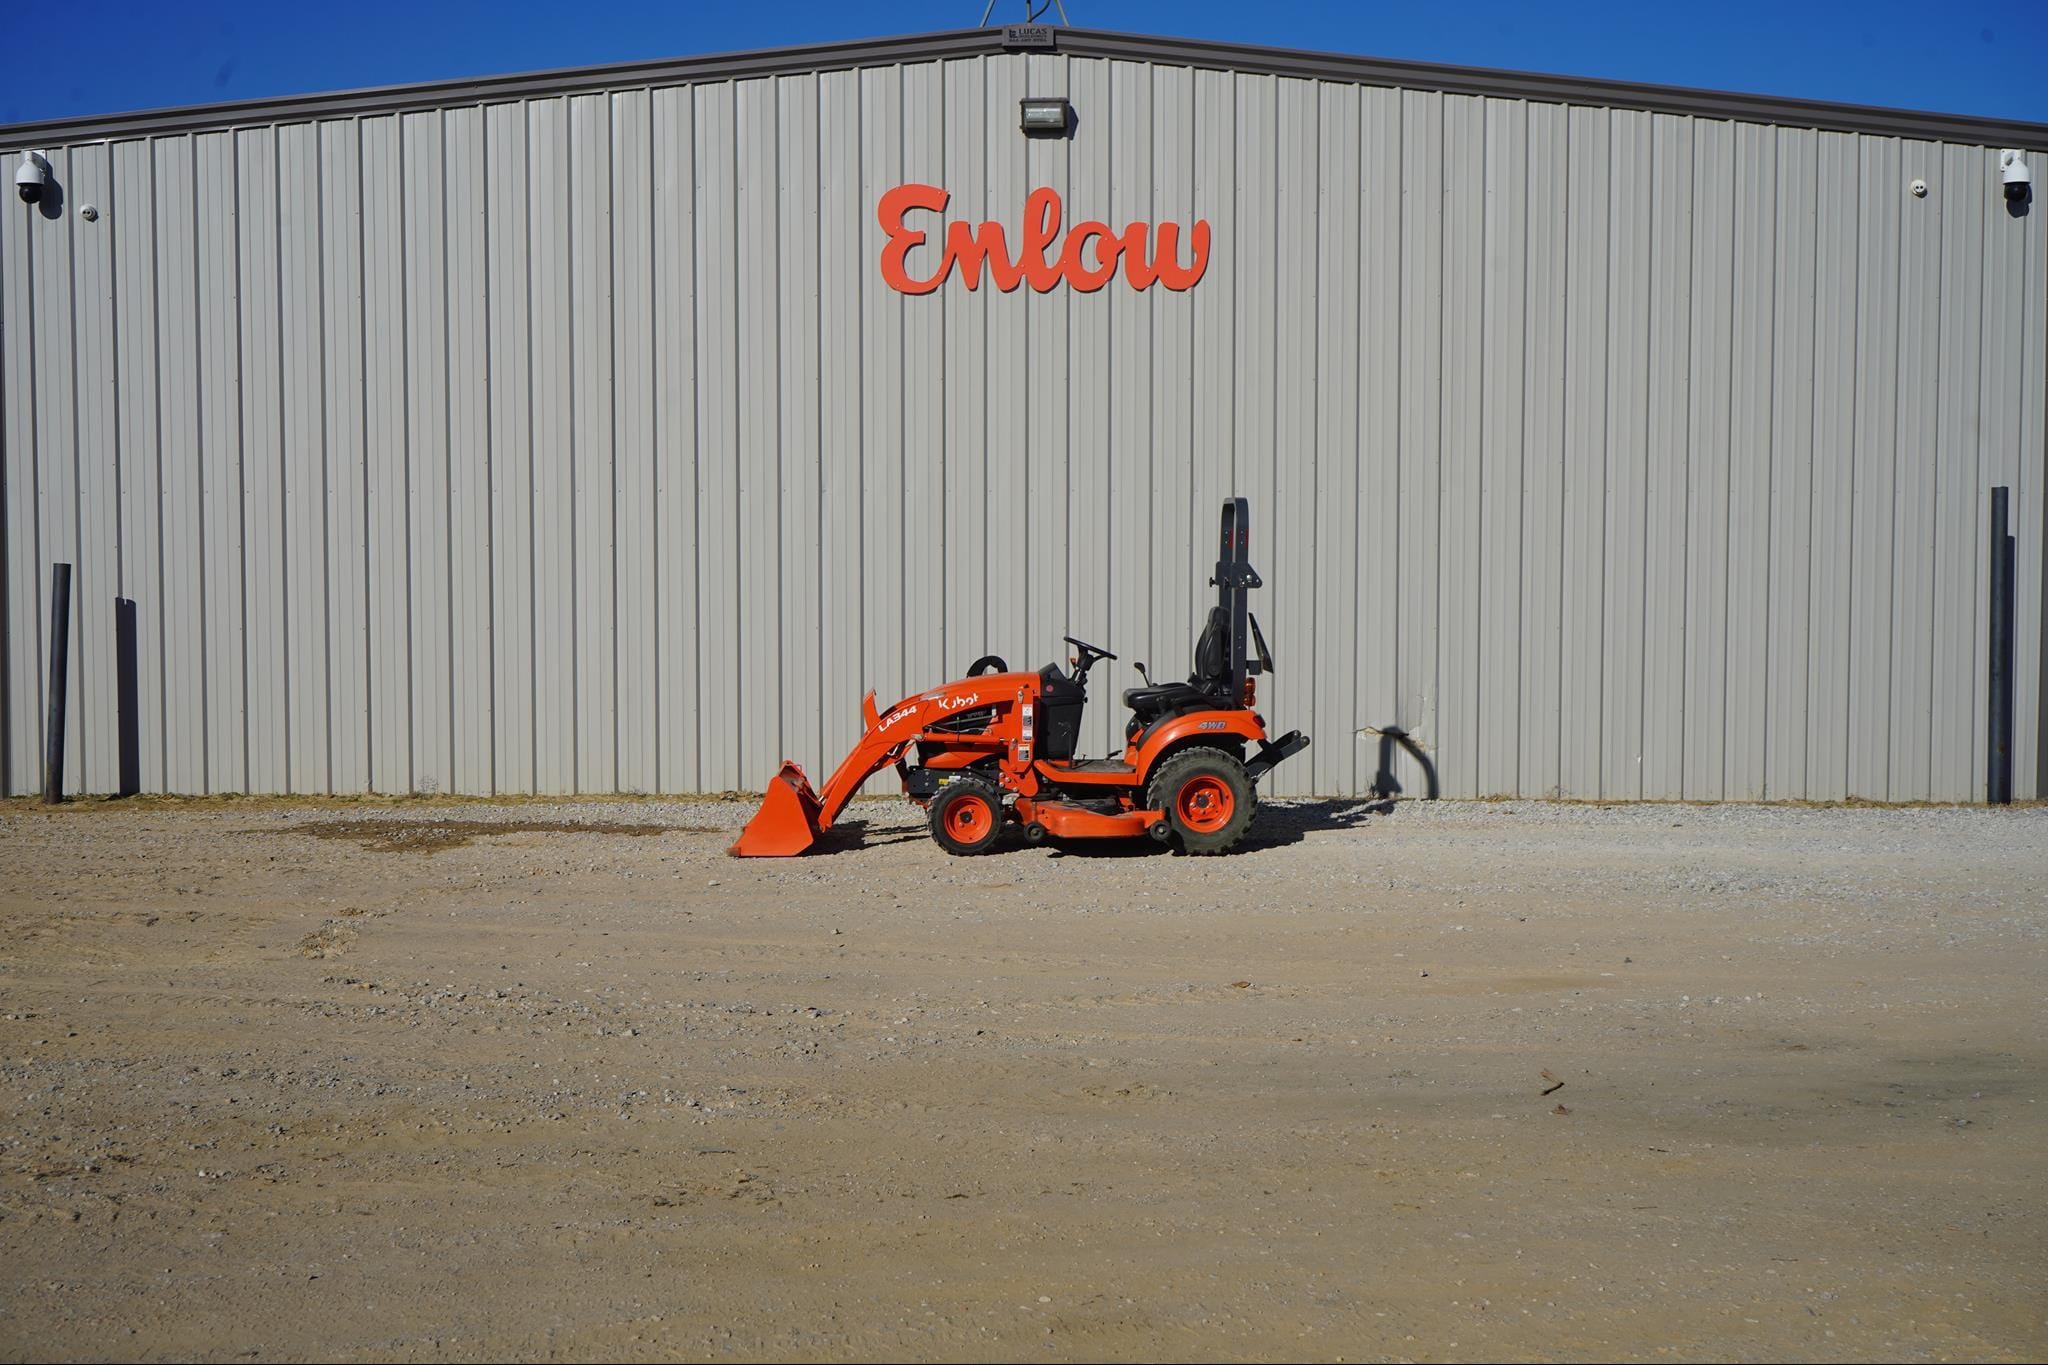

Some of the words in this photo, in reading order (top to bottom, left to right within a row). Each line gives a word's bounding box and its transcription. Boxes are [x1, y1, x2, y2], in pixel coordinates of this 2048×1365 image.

[877, 183, 1211, 295] Enlow
[878, 705, 918, 732] LA344
[1197, 721, 1226, 730] 4WD
